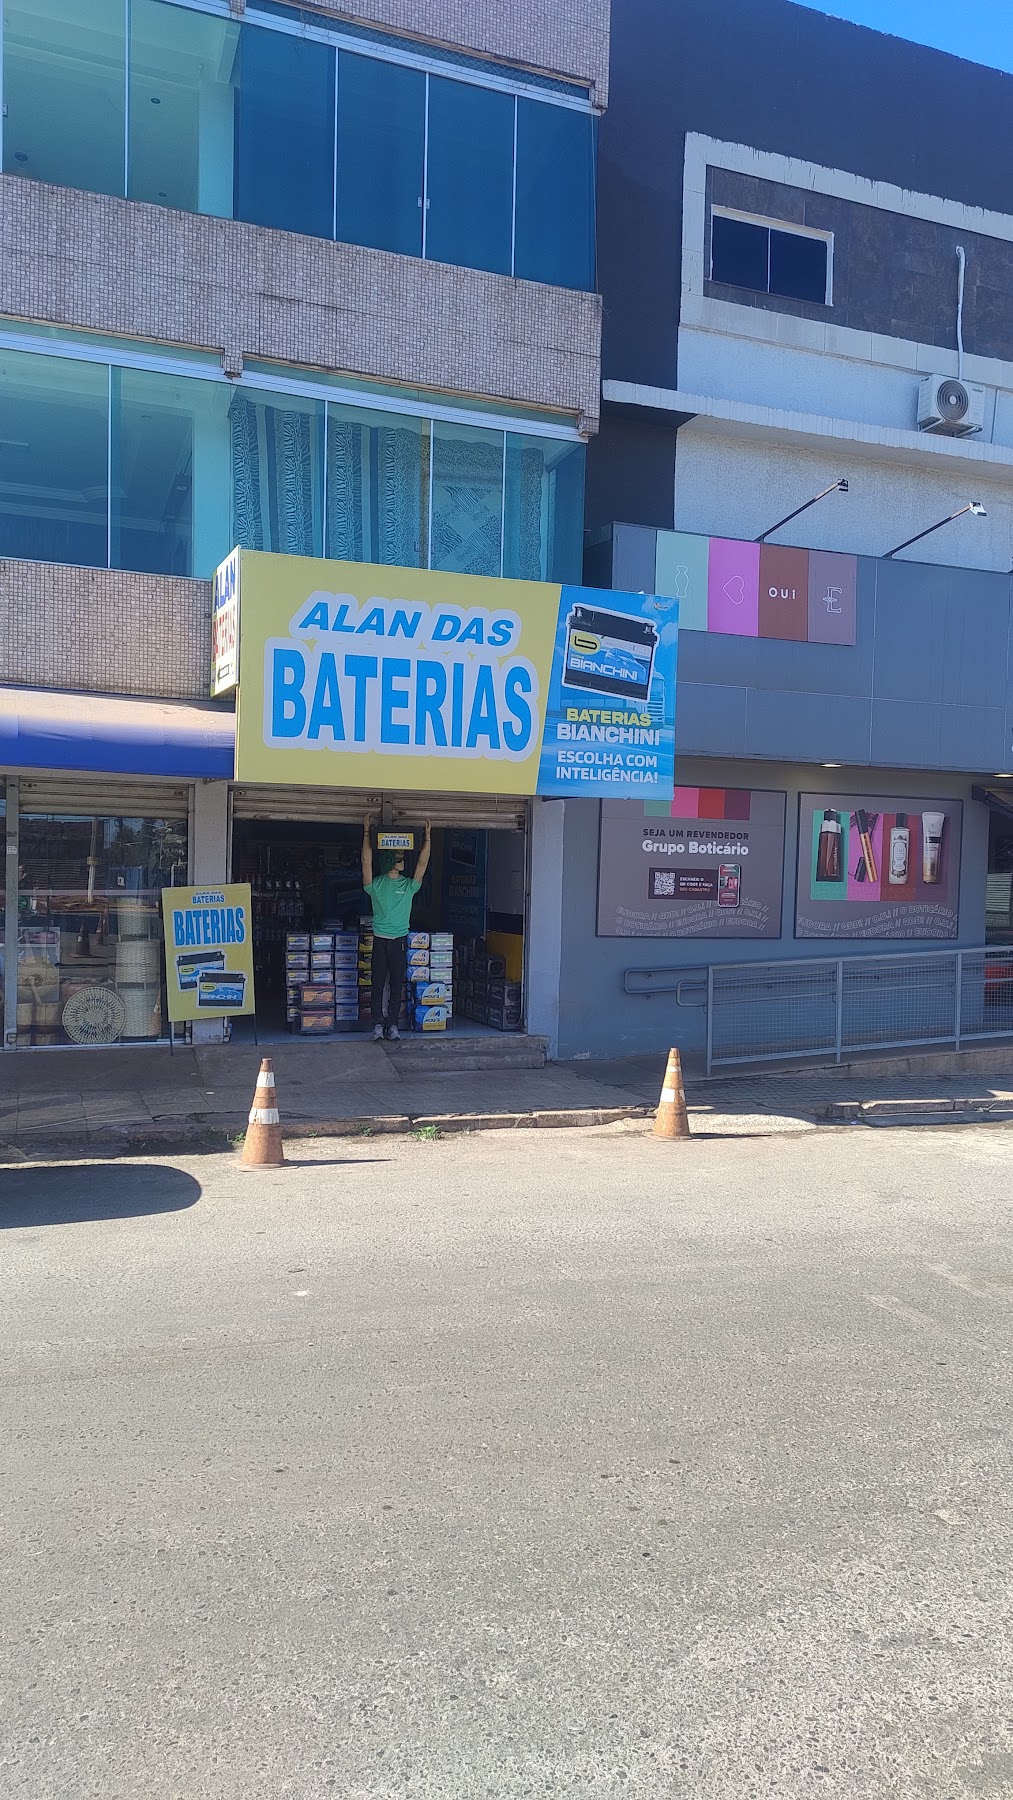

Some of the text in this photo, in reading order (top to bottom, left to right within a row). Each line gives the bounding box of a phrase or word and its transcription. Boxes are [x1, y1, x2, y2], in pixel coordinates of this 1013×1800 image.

[214, 557, 236, 613] ALAN
[299, 602, 514, 647] ALAN DAS
[570, 657, 638, 680] BIANCHINI
[272, 648, 532, 752] BATERIAS
[566, 708, 652, 726] BATERIAS
[557, 723, 660, 745] BIANCHINI
[558, 751, 657, 767] ESCOLHA COM
[556, 766, 658, 783] INTELIGÊNCIA!
[382, 839, 410, 847] BATERIAS
[643, 829, 666, 837] SEJA
[687, 831, 749, 840] REVENDEDOR
[642, 839, 749, 855] Grupo Boticário
[192, 895, 225, 904] BATERIAS
[908, 904, 953, 917] BOTICÁRIO
[173, 907, 245, 946] BATERIAS
